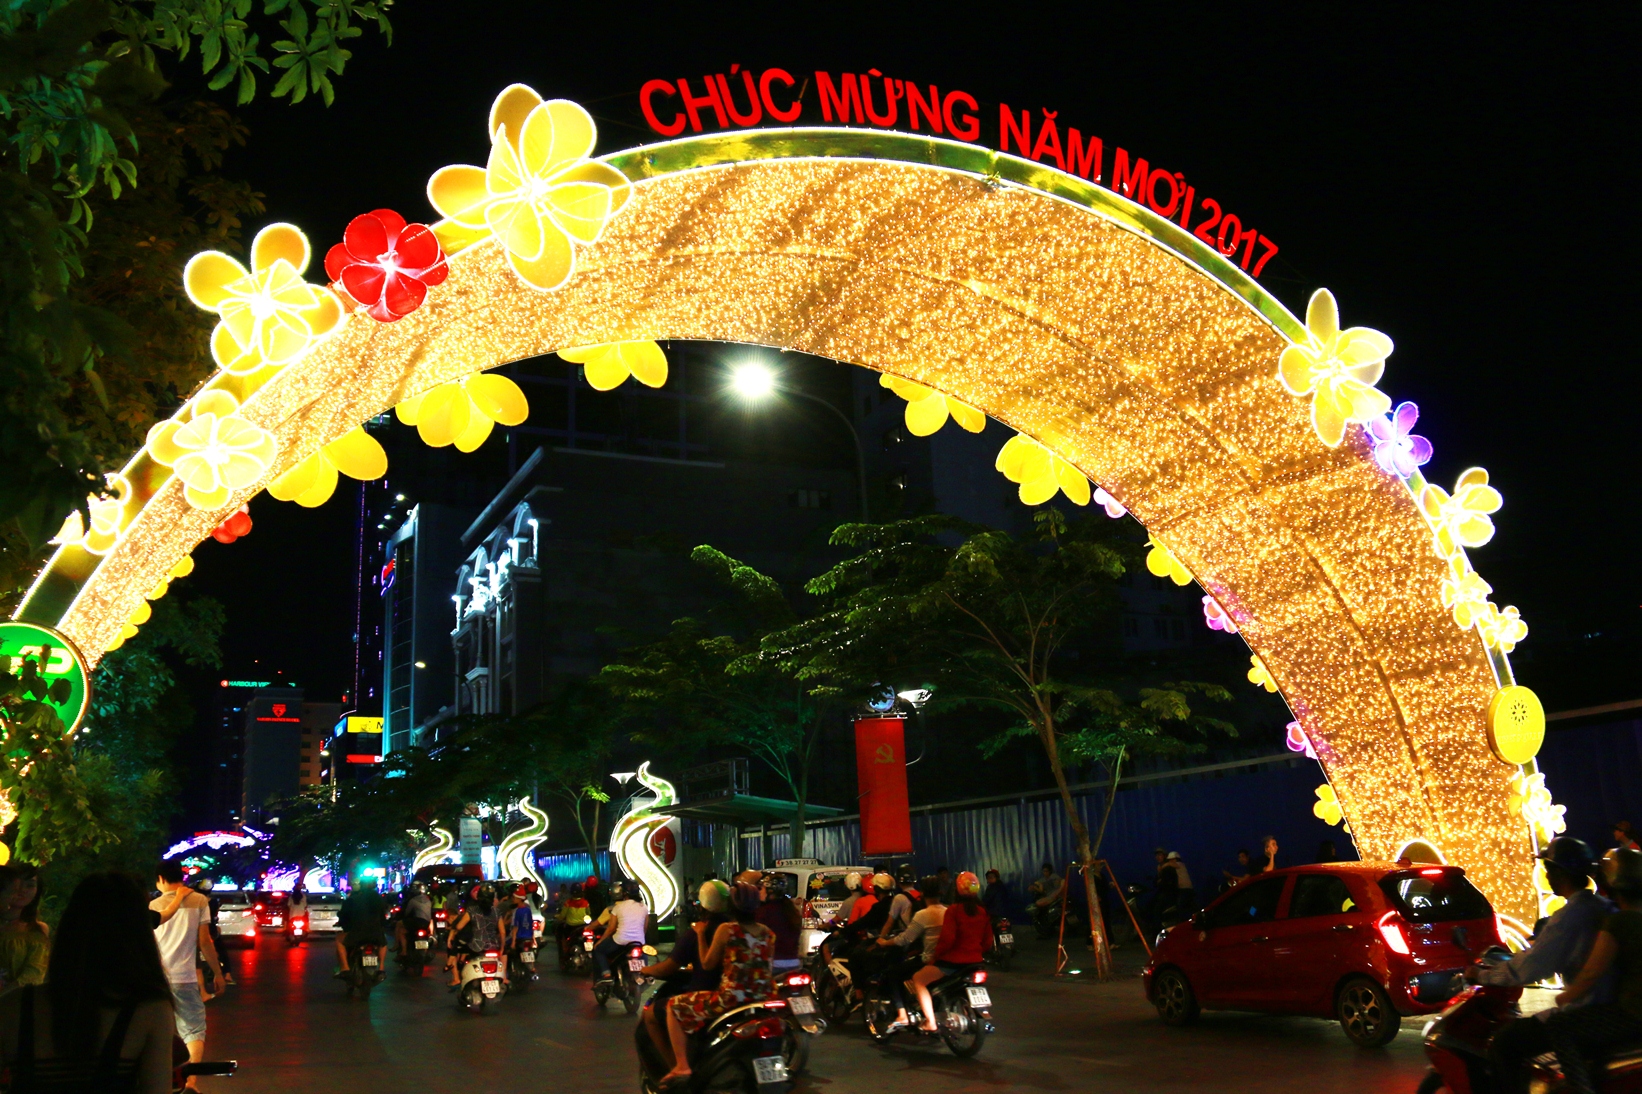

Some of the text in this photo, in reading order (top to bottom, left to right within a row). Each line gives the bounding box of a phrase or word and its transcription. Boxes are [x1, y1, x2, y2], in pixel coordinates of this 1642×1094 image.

[640, 64, 802, 136] CHÚC
[815, 68, 980, 142] MỪNG
[1000, 102, 1104, 184] NĂM
[1194, 198, 1279, 278] 2017
